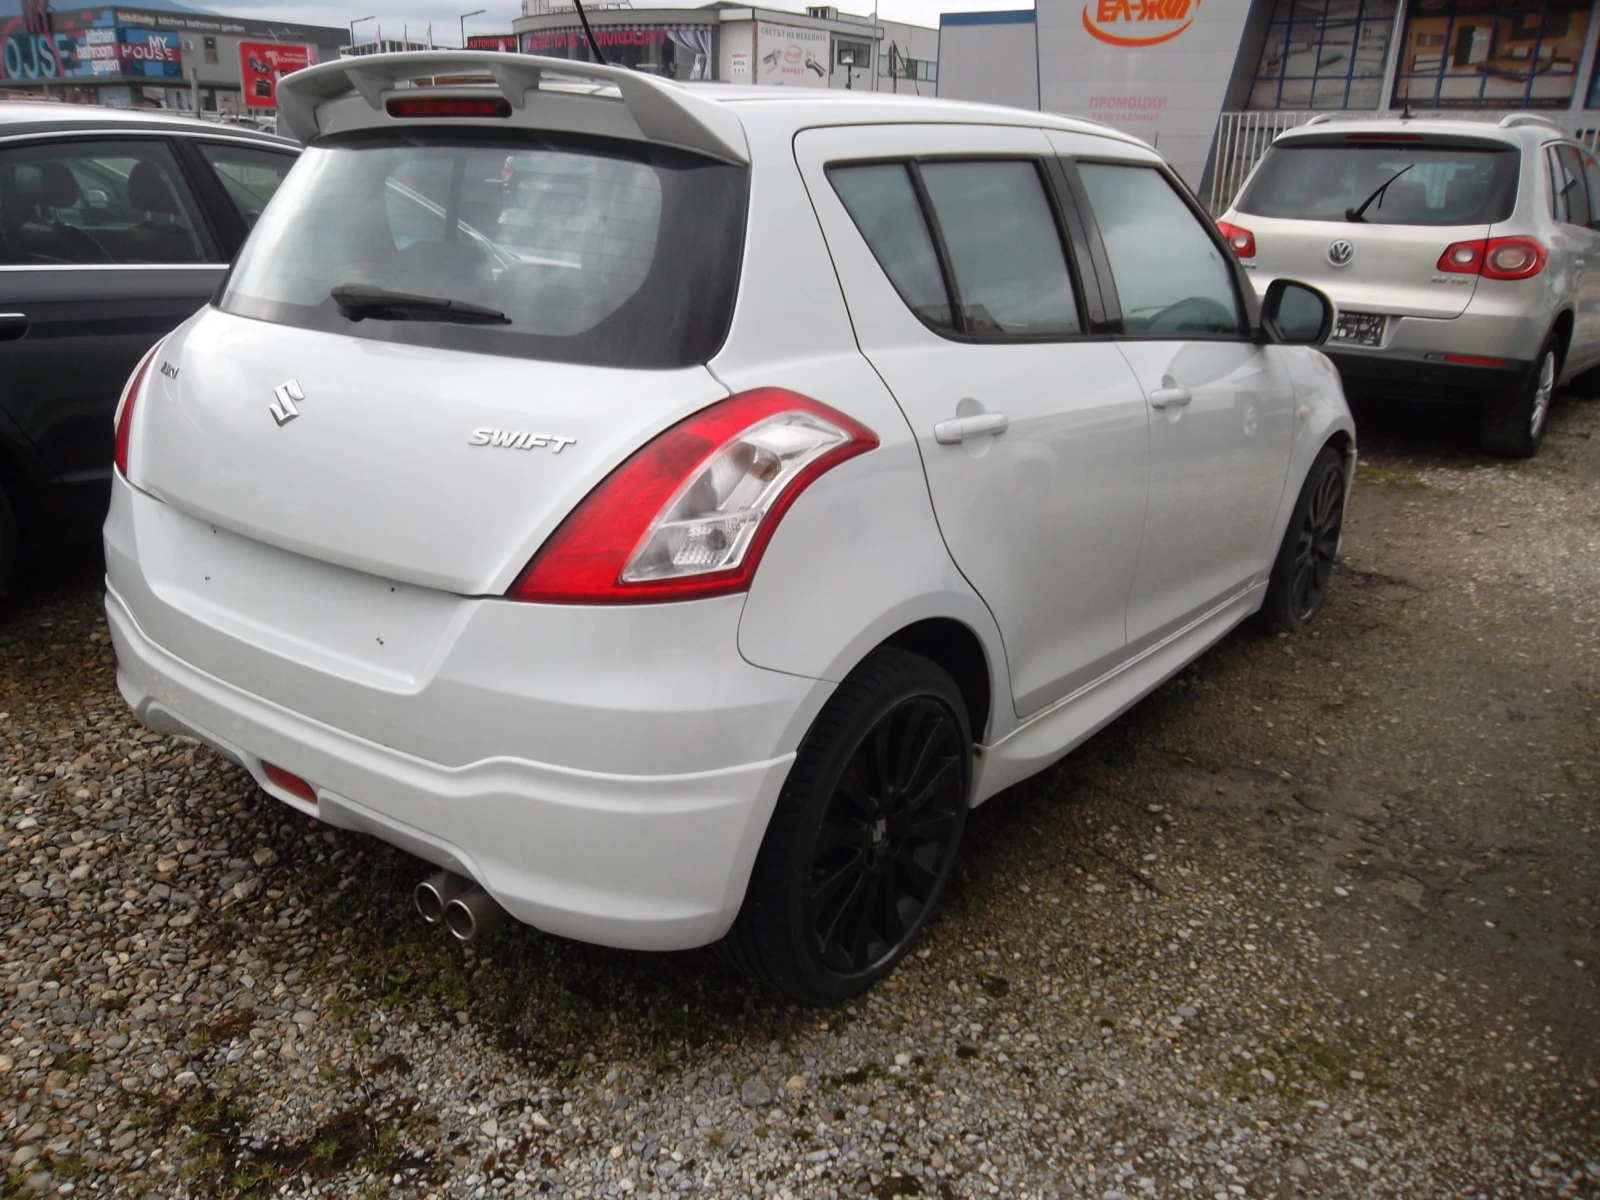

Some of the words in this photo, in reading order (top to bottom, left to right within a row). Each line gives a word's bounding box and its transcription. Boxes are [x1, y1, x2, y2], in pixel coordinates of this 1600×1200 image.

[158, 15, 185, 27] kitchen
[186, 19, 220, 30] bathroom
[222, 23, 246, 33] garden
[85, 28, 117, 44] kitchen
[148, 35, 168, 50] MY
[76, 44, 114, 60] bathroom
[121, 45, 174, 61] HOUSE
[92, 60, 120, 76] garden
[1089, 96, 1168, 109] ПРОМОЦИИ
[467, 427, 577, 454] SWIFT
